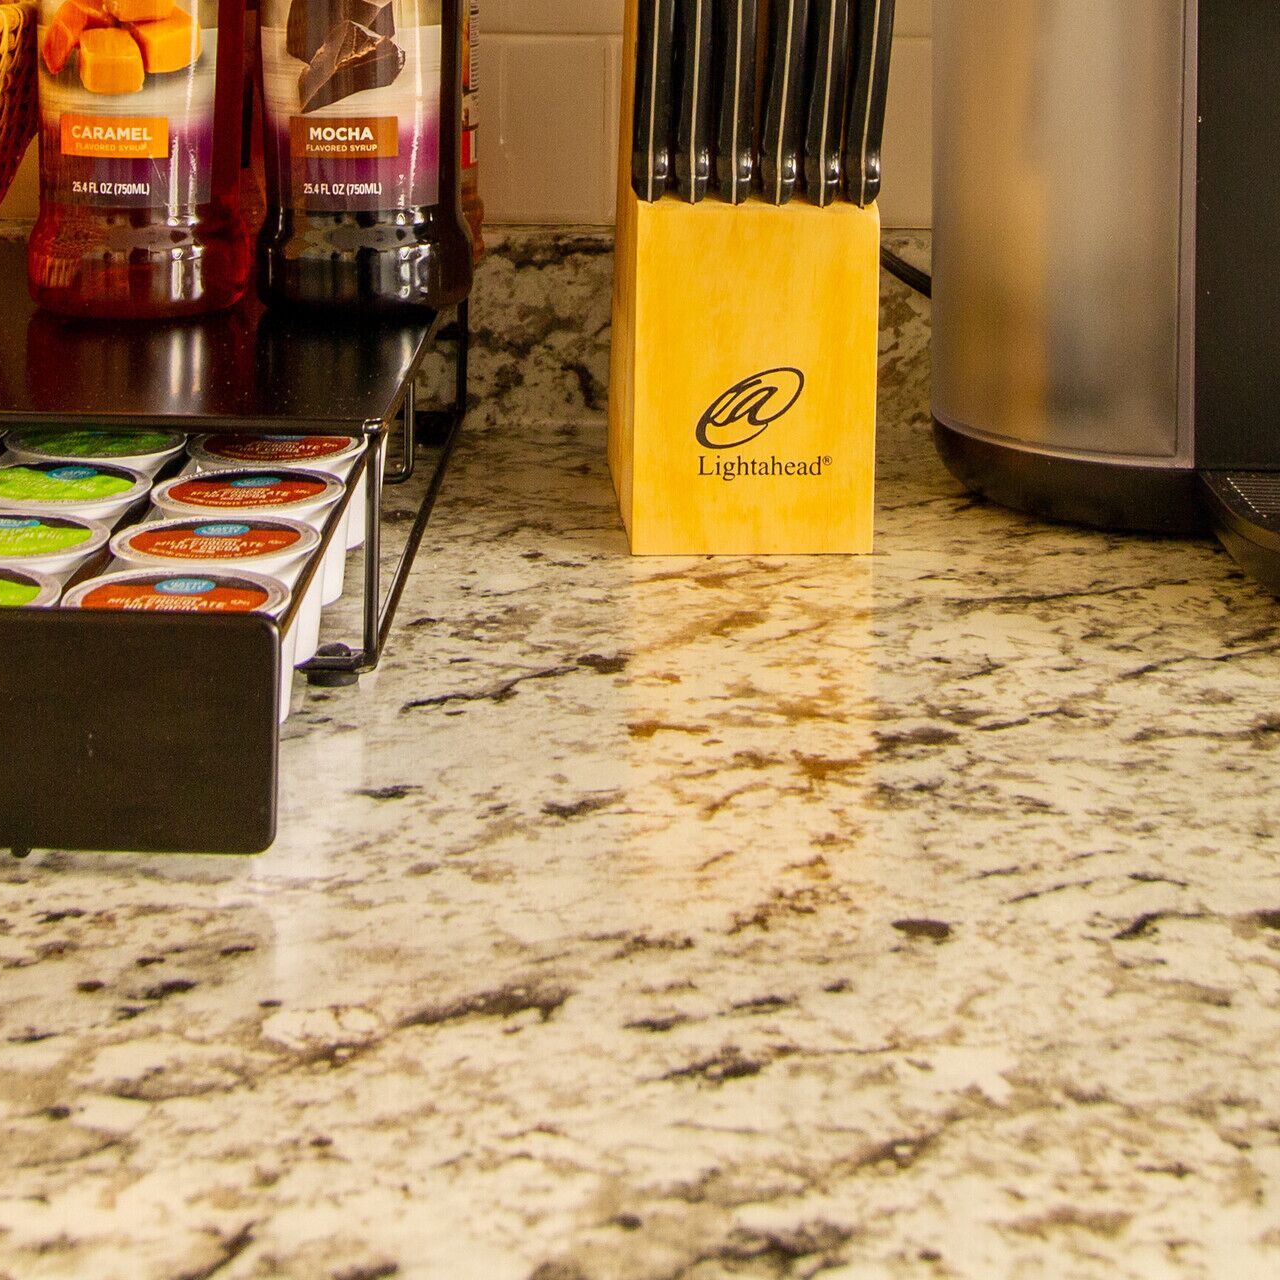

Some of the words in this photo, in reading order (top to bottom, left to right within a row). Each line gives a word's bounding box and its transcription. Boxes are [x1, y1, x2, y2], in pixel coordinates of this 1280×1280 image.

[71, 125, 152, 141] CARAMEL
[309, 127, 374, 141] MOCHA
[75, 142, 116, 151] FLAVORED
[119, 143, 147, 151] SYRUP
[306, 144, 347, 152] FLAVORED
[350, 144, 378, 152] SYRUP
[72, 181, 87, 192] 25.4
[88, 182, 98, 193] FL
[100, 182, 113, 194] OZ
[114, 182, 150, 195] (750ML)
[304, 183, 319, 194] 25.4
[320, 183, 330, 194] FL
[332, 183, 345, 195] OZ
[346, 182, 382, 195] (750ML)
